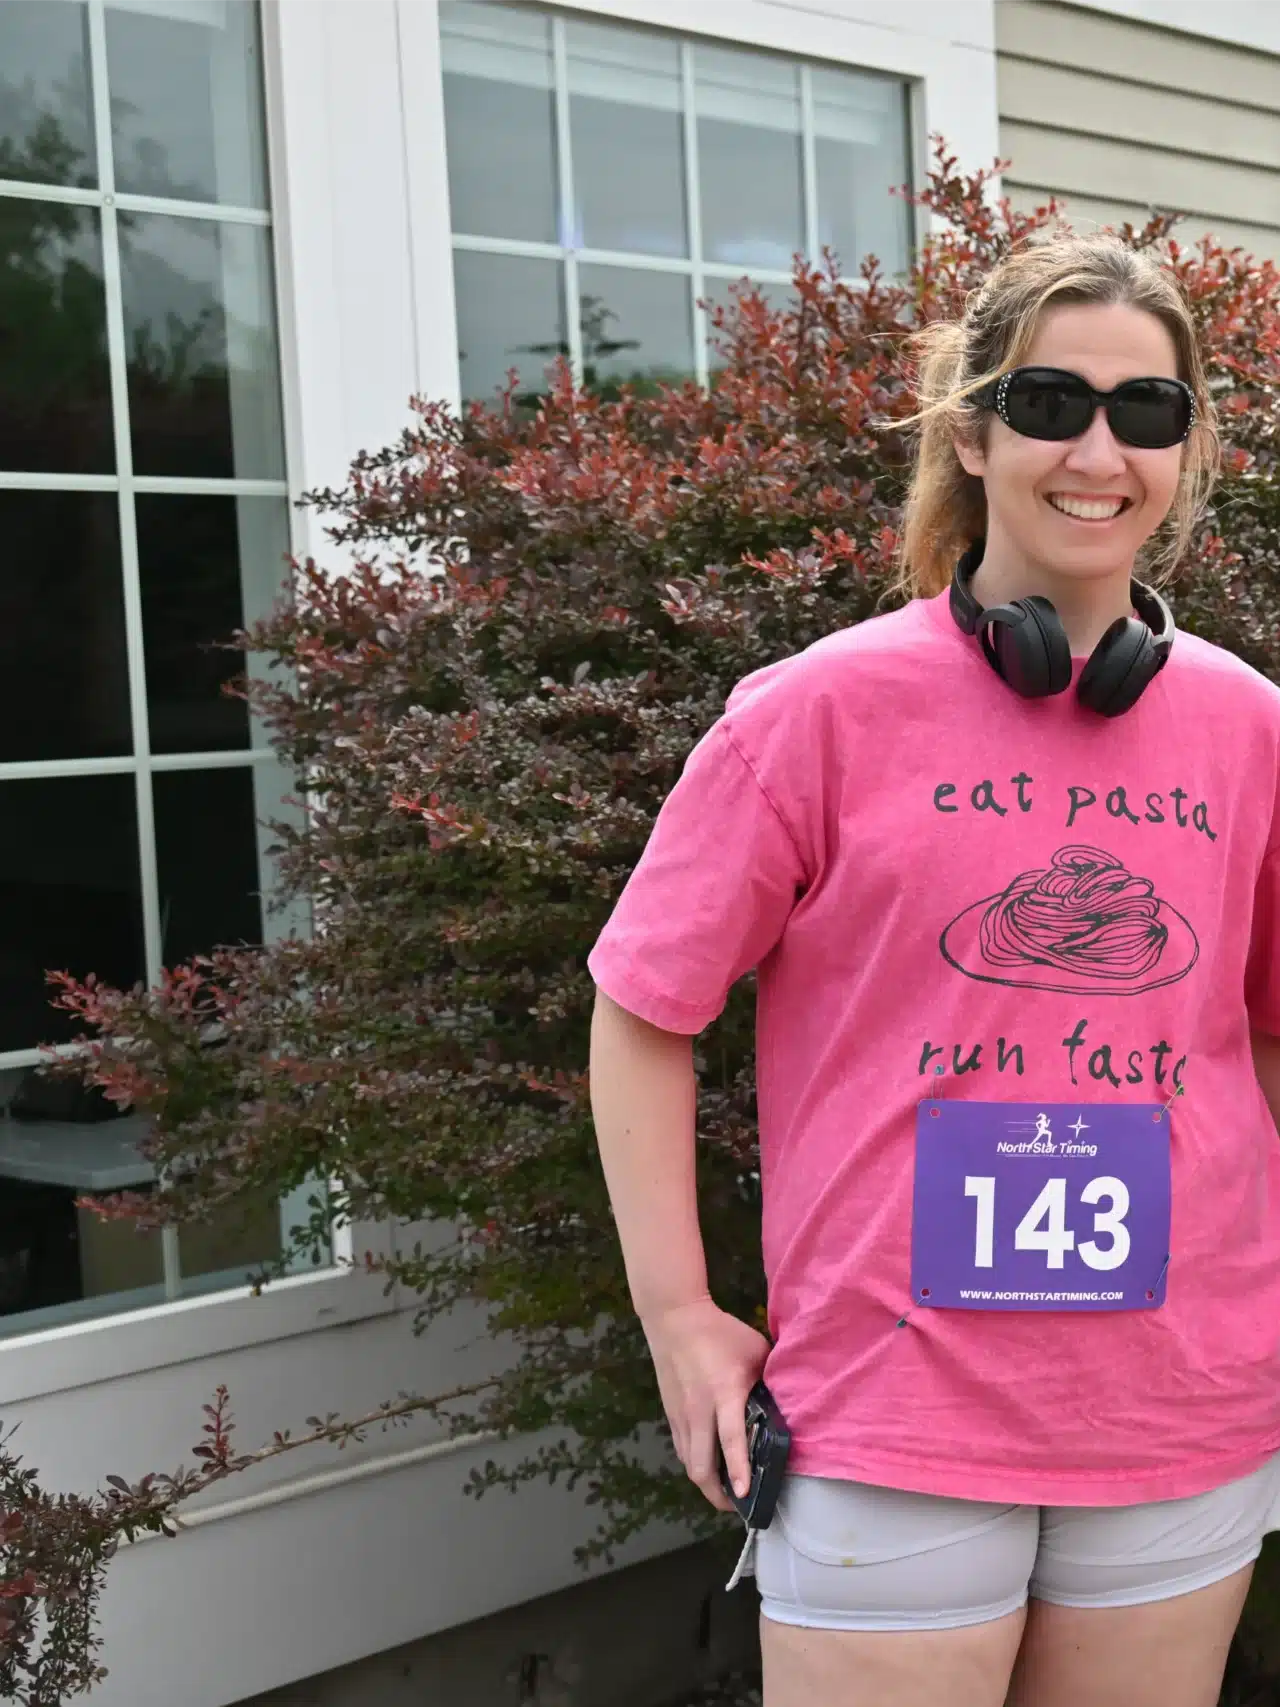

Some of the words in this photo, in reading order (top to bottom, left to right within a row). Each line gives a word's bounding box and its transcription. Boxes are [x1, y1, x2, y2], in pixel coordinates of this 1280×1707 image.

[933, 772, 1034, 816] eat
[1066, 786, 1217, 842] pasta
[918, 1038, 1025, 1076] run
[997, 1142, 1031, 1153] North
[1033, 1142, 1057, 1154] Star
[1059, 1140, 1098, 1157] Timing
[964, 1175, 1131, 1271] 143
[960, 1290, 1124, 1301] WWW.NORTHSTARTIMING.COM
